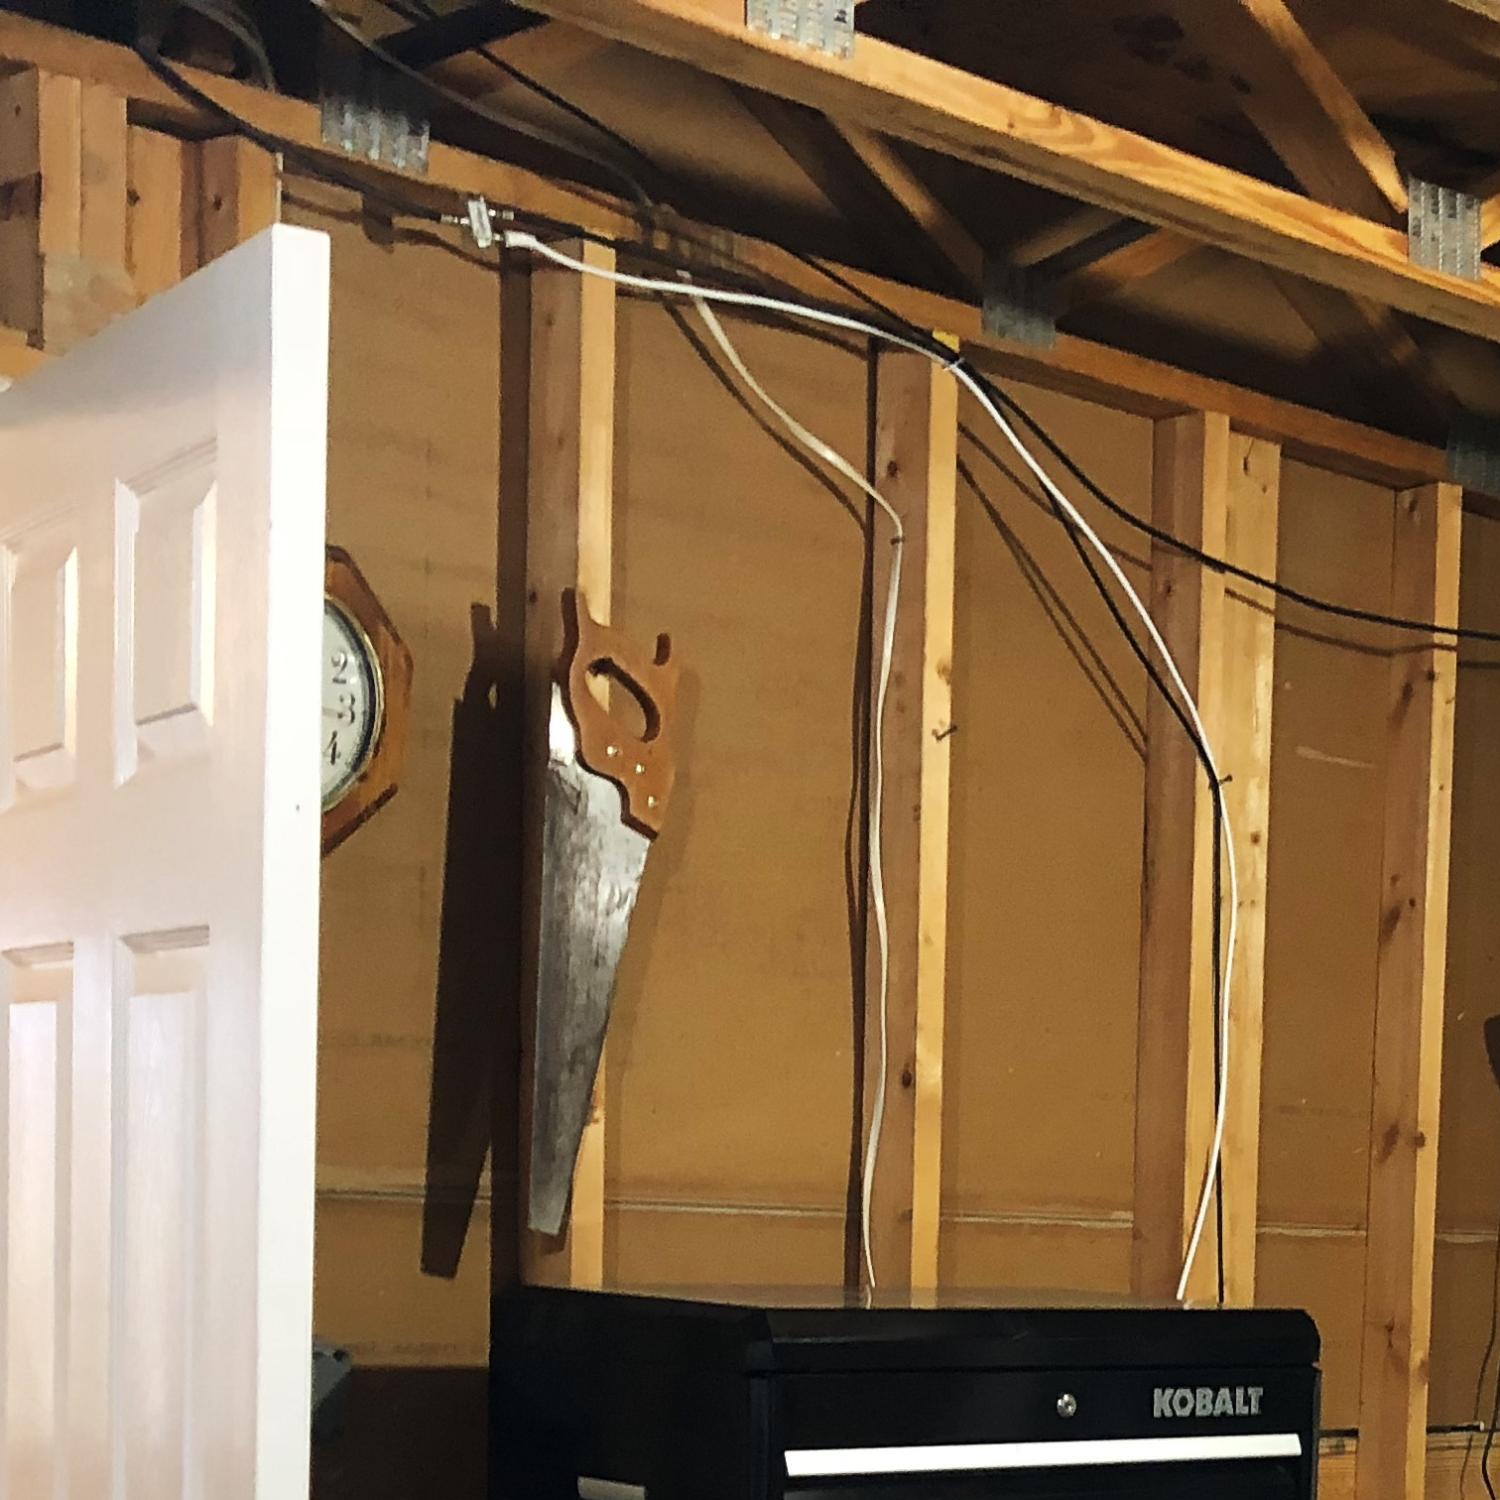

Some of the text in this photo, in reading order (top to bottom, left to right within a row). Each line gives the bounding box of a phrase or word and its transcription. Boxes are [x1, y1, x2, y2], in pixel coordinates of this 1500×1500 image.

[331, 650, 348, 684] 2
[336, 693, 356, 727] 3
[322, 730, 341, 766] 4
[1152, 1386, 1264, 1419] KOBALT
